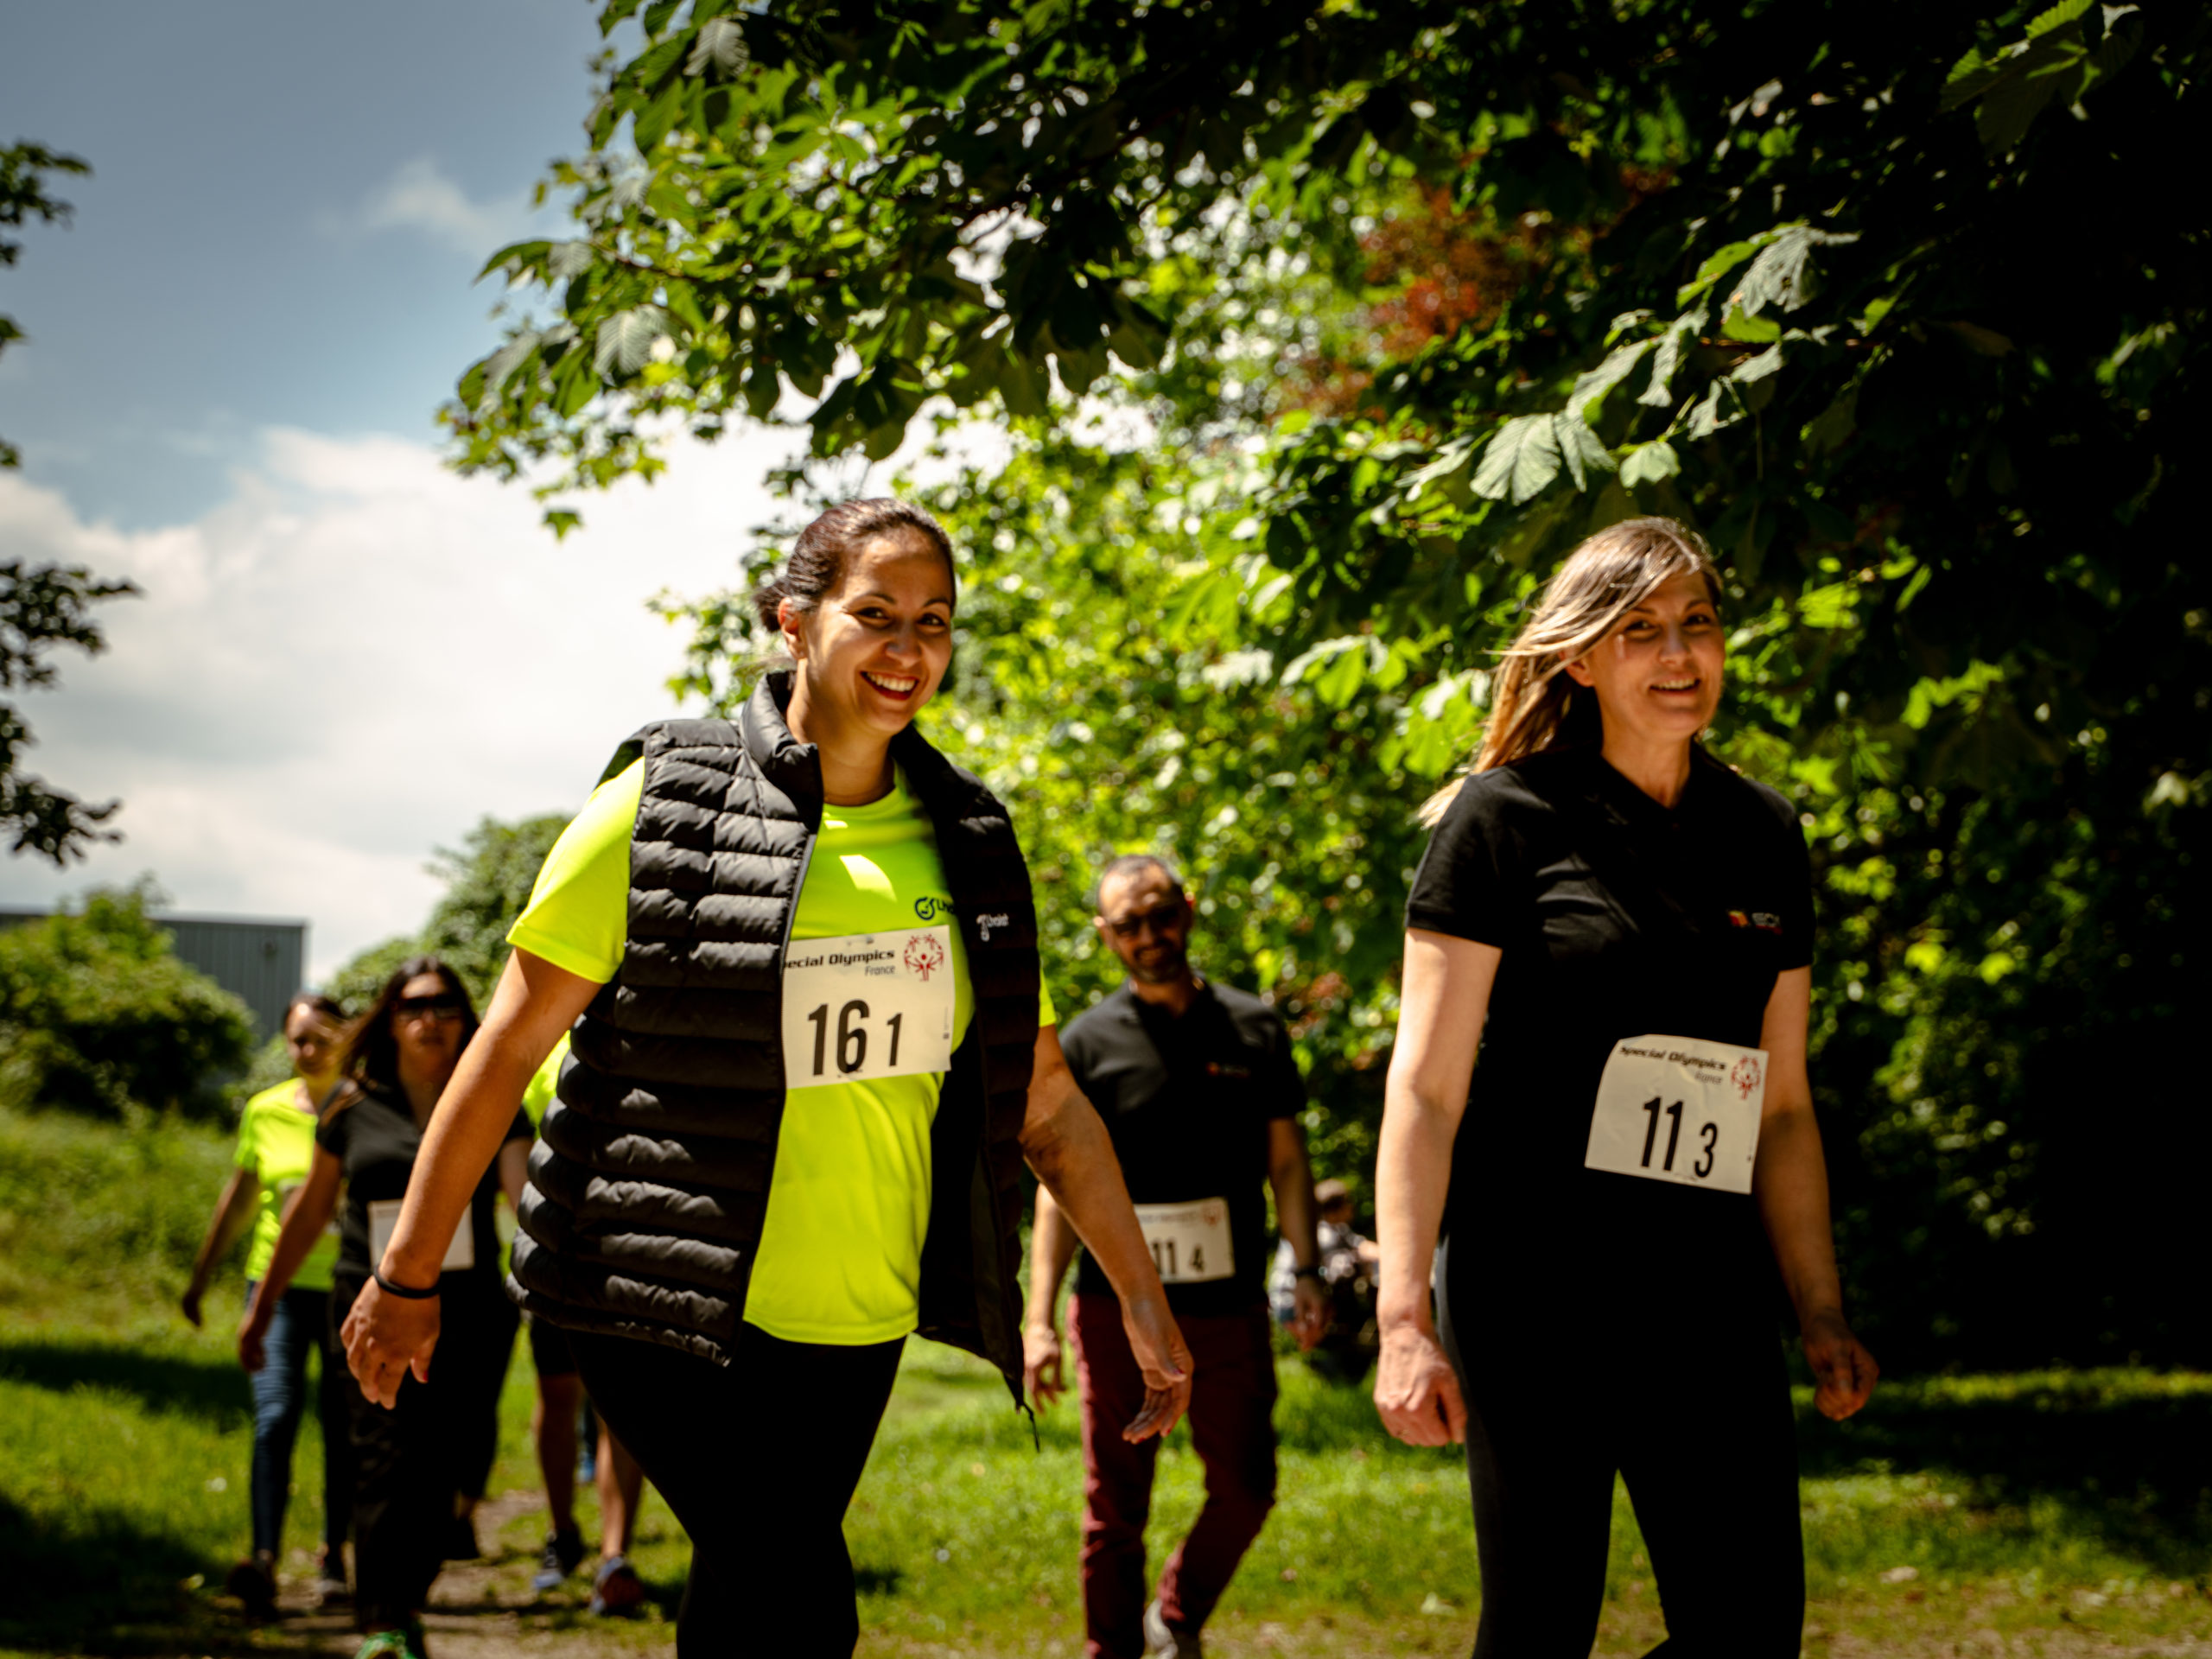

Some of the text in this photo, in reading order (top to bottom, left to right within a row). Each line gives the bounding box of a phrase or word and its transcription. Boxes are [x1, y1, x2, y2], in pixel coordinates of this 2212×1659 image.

[784, 949, 895, 969] ecial Olympics
[864, 965, 896, 976] France
[808, 999, 870, 1077] 16
[886, 1012, 903, 1067] 1
[1618, 1046, 1727, 1071] Special Olympics
[1640, 1096, 1719, 1179] 11 3
[1189, 1246, 1205, 1272] 4
